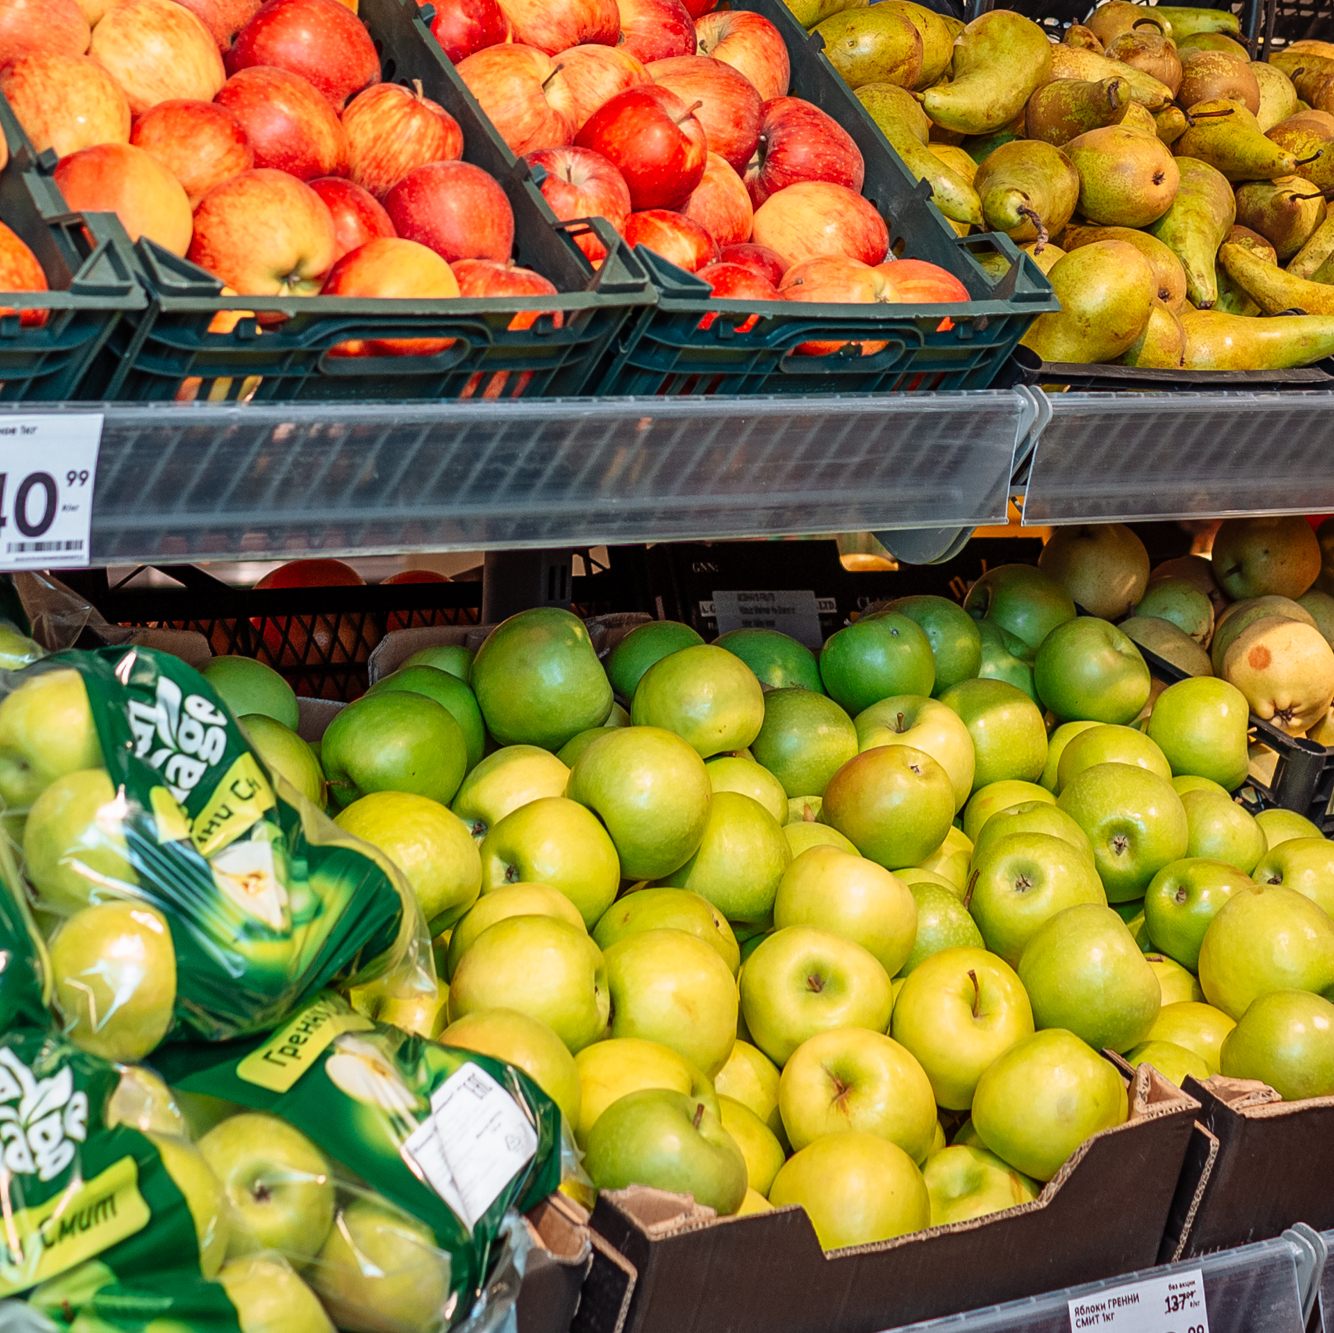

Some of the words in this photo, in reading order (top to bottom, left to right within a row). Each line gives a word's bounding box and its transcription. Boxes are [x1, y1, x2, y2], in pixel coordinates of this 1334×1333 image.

[66, 470, 90, 487] 99
[38, 1193, 118, 1249] Смит
[1074, 1301, 1106, 1318] Яблоки
[1107, 1292, 1140, 1310] ГРЕННИ
[1075, 1314, 1100, 1329] СМИТ
[1102, 1312, 1115, 1322] 1кг
